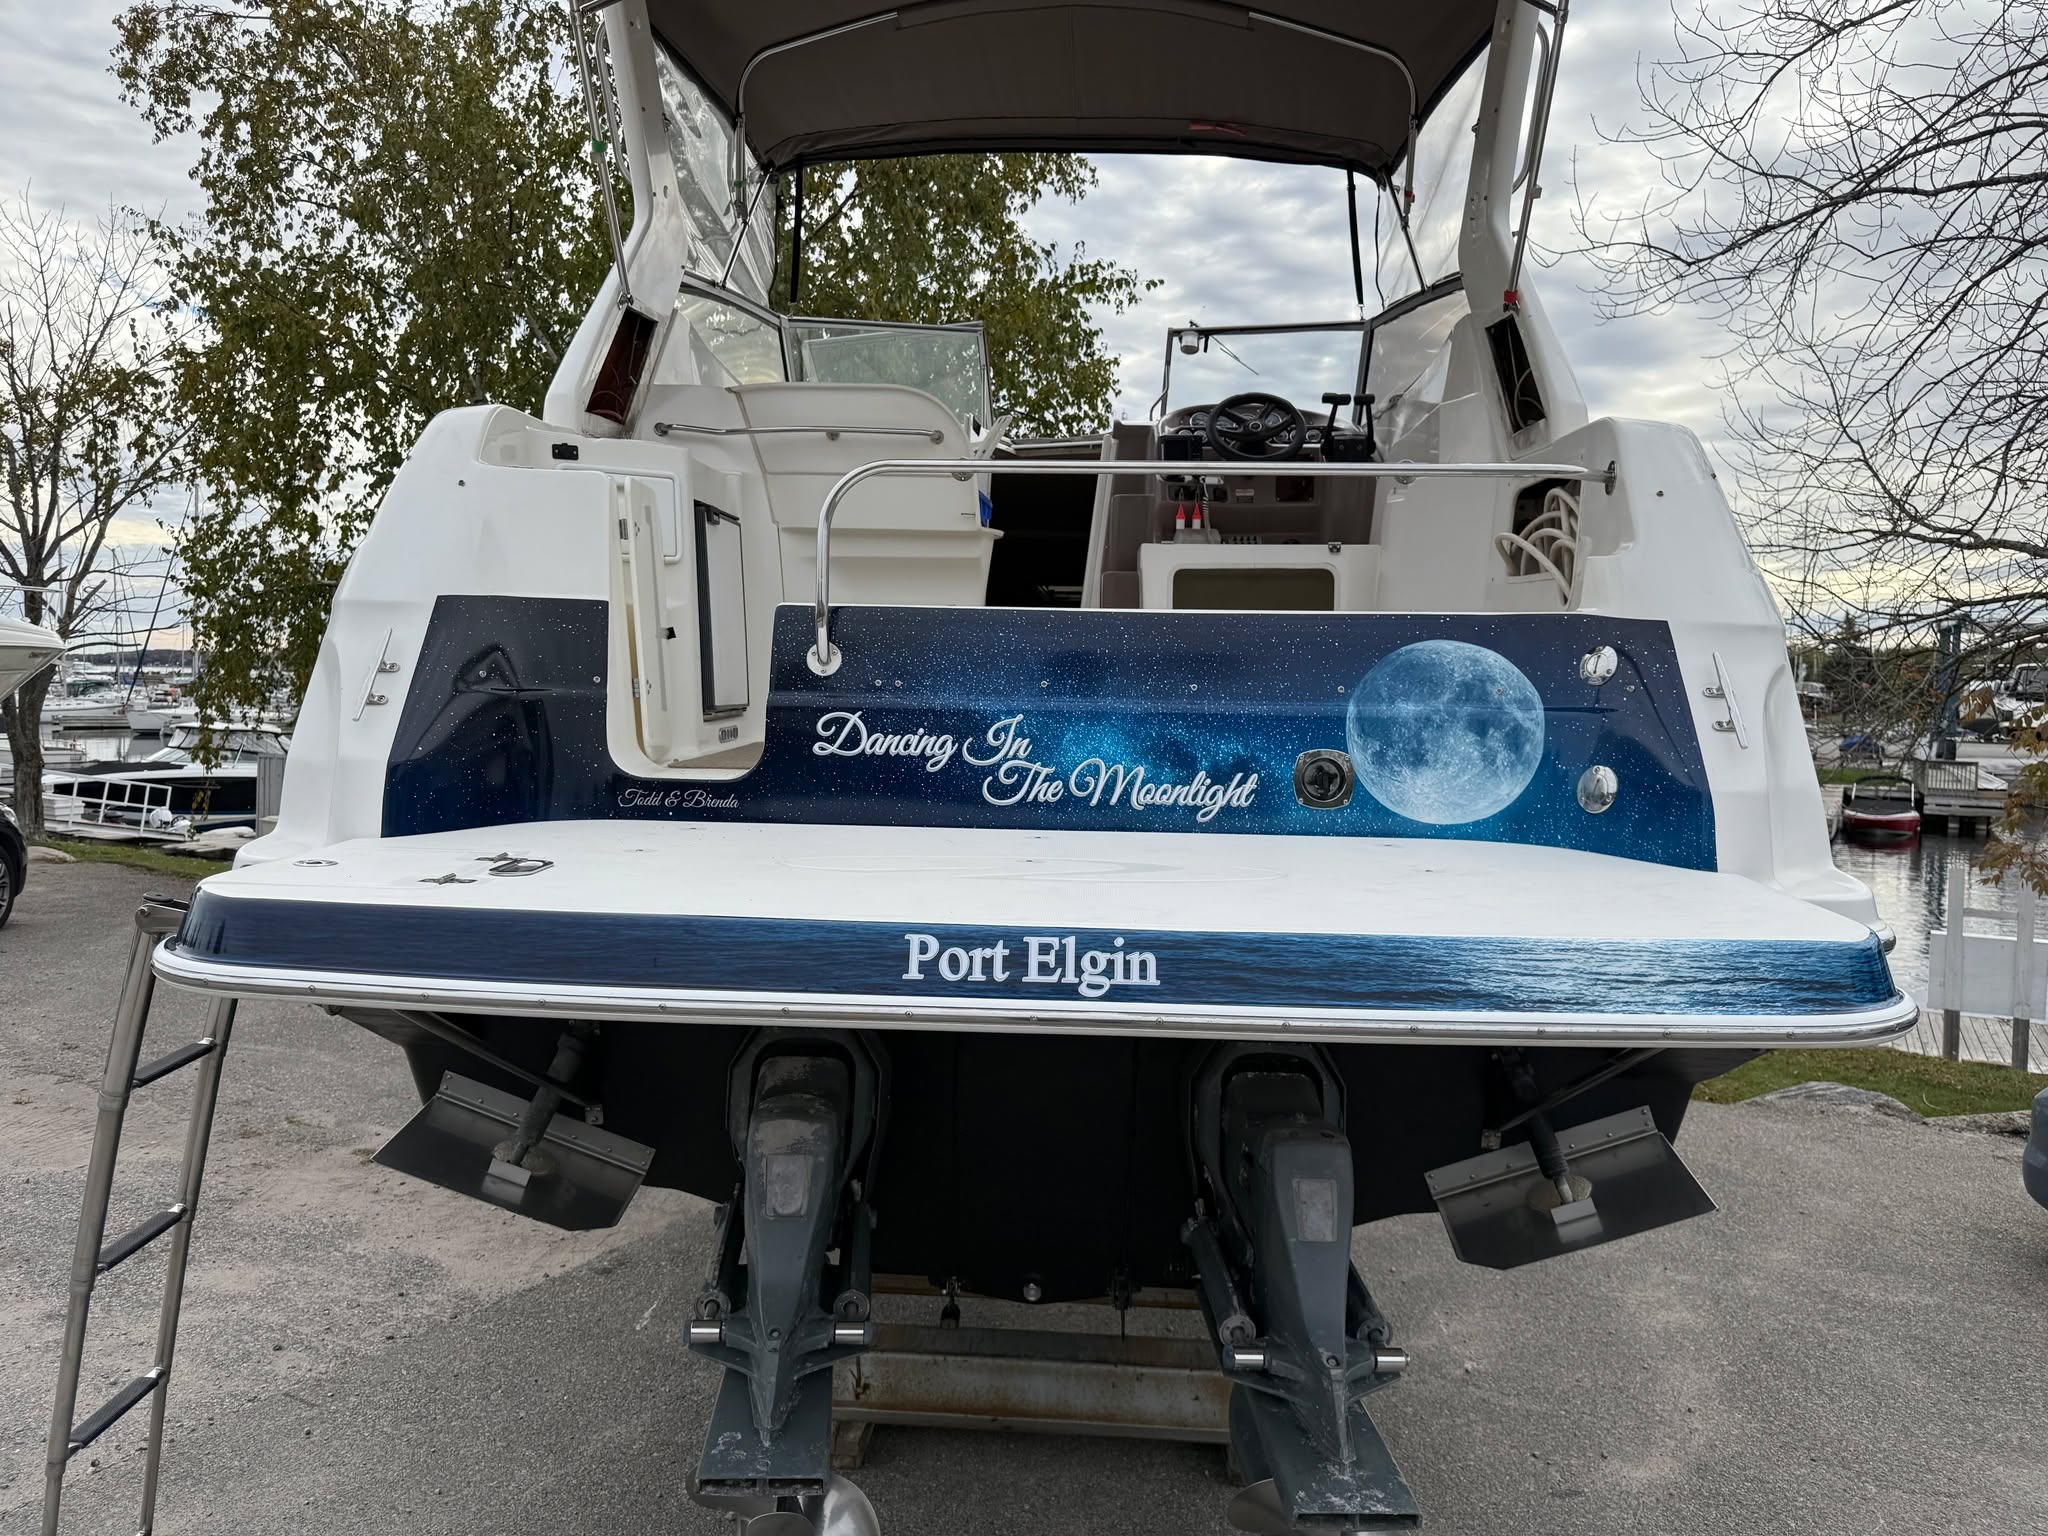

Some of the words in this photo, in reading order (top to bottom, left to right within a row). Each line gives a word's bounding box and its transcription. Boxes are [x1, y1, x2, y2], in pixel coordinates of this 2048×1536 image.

[812, 711, 958, 773] Dancing
[962, 713, 1033, 766] In
[617, 788, 664, 808] Todd
[664, 790, 681, 808] &
[682, 789, 740, 808] Brenda
[982, 759, 1064, 806] The
[1069, 758, 1259, 823] Moonlight
[902, 933, 1010, 982] Port
[1021, 935, 1161, 998] Elgin
